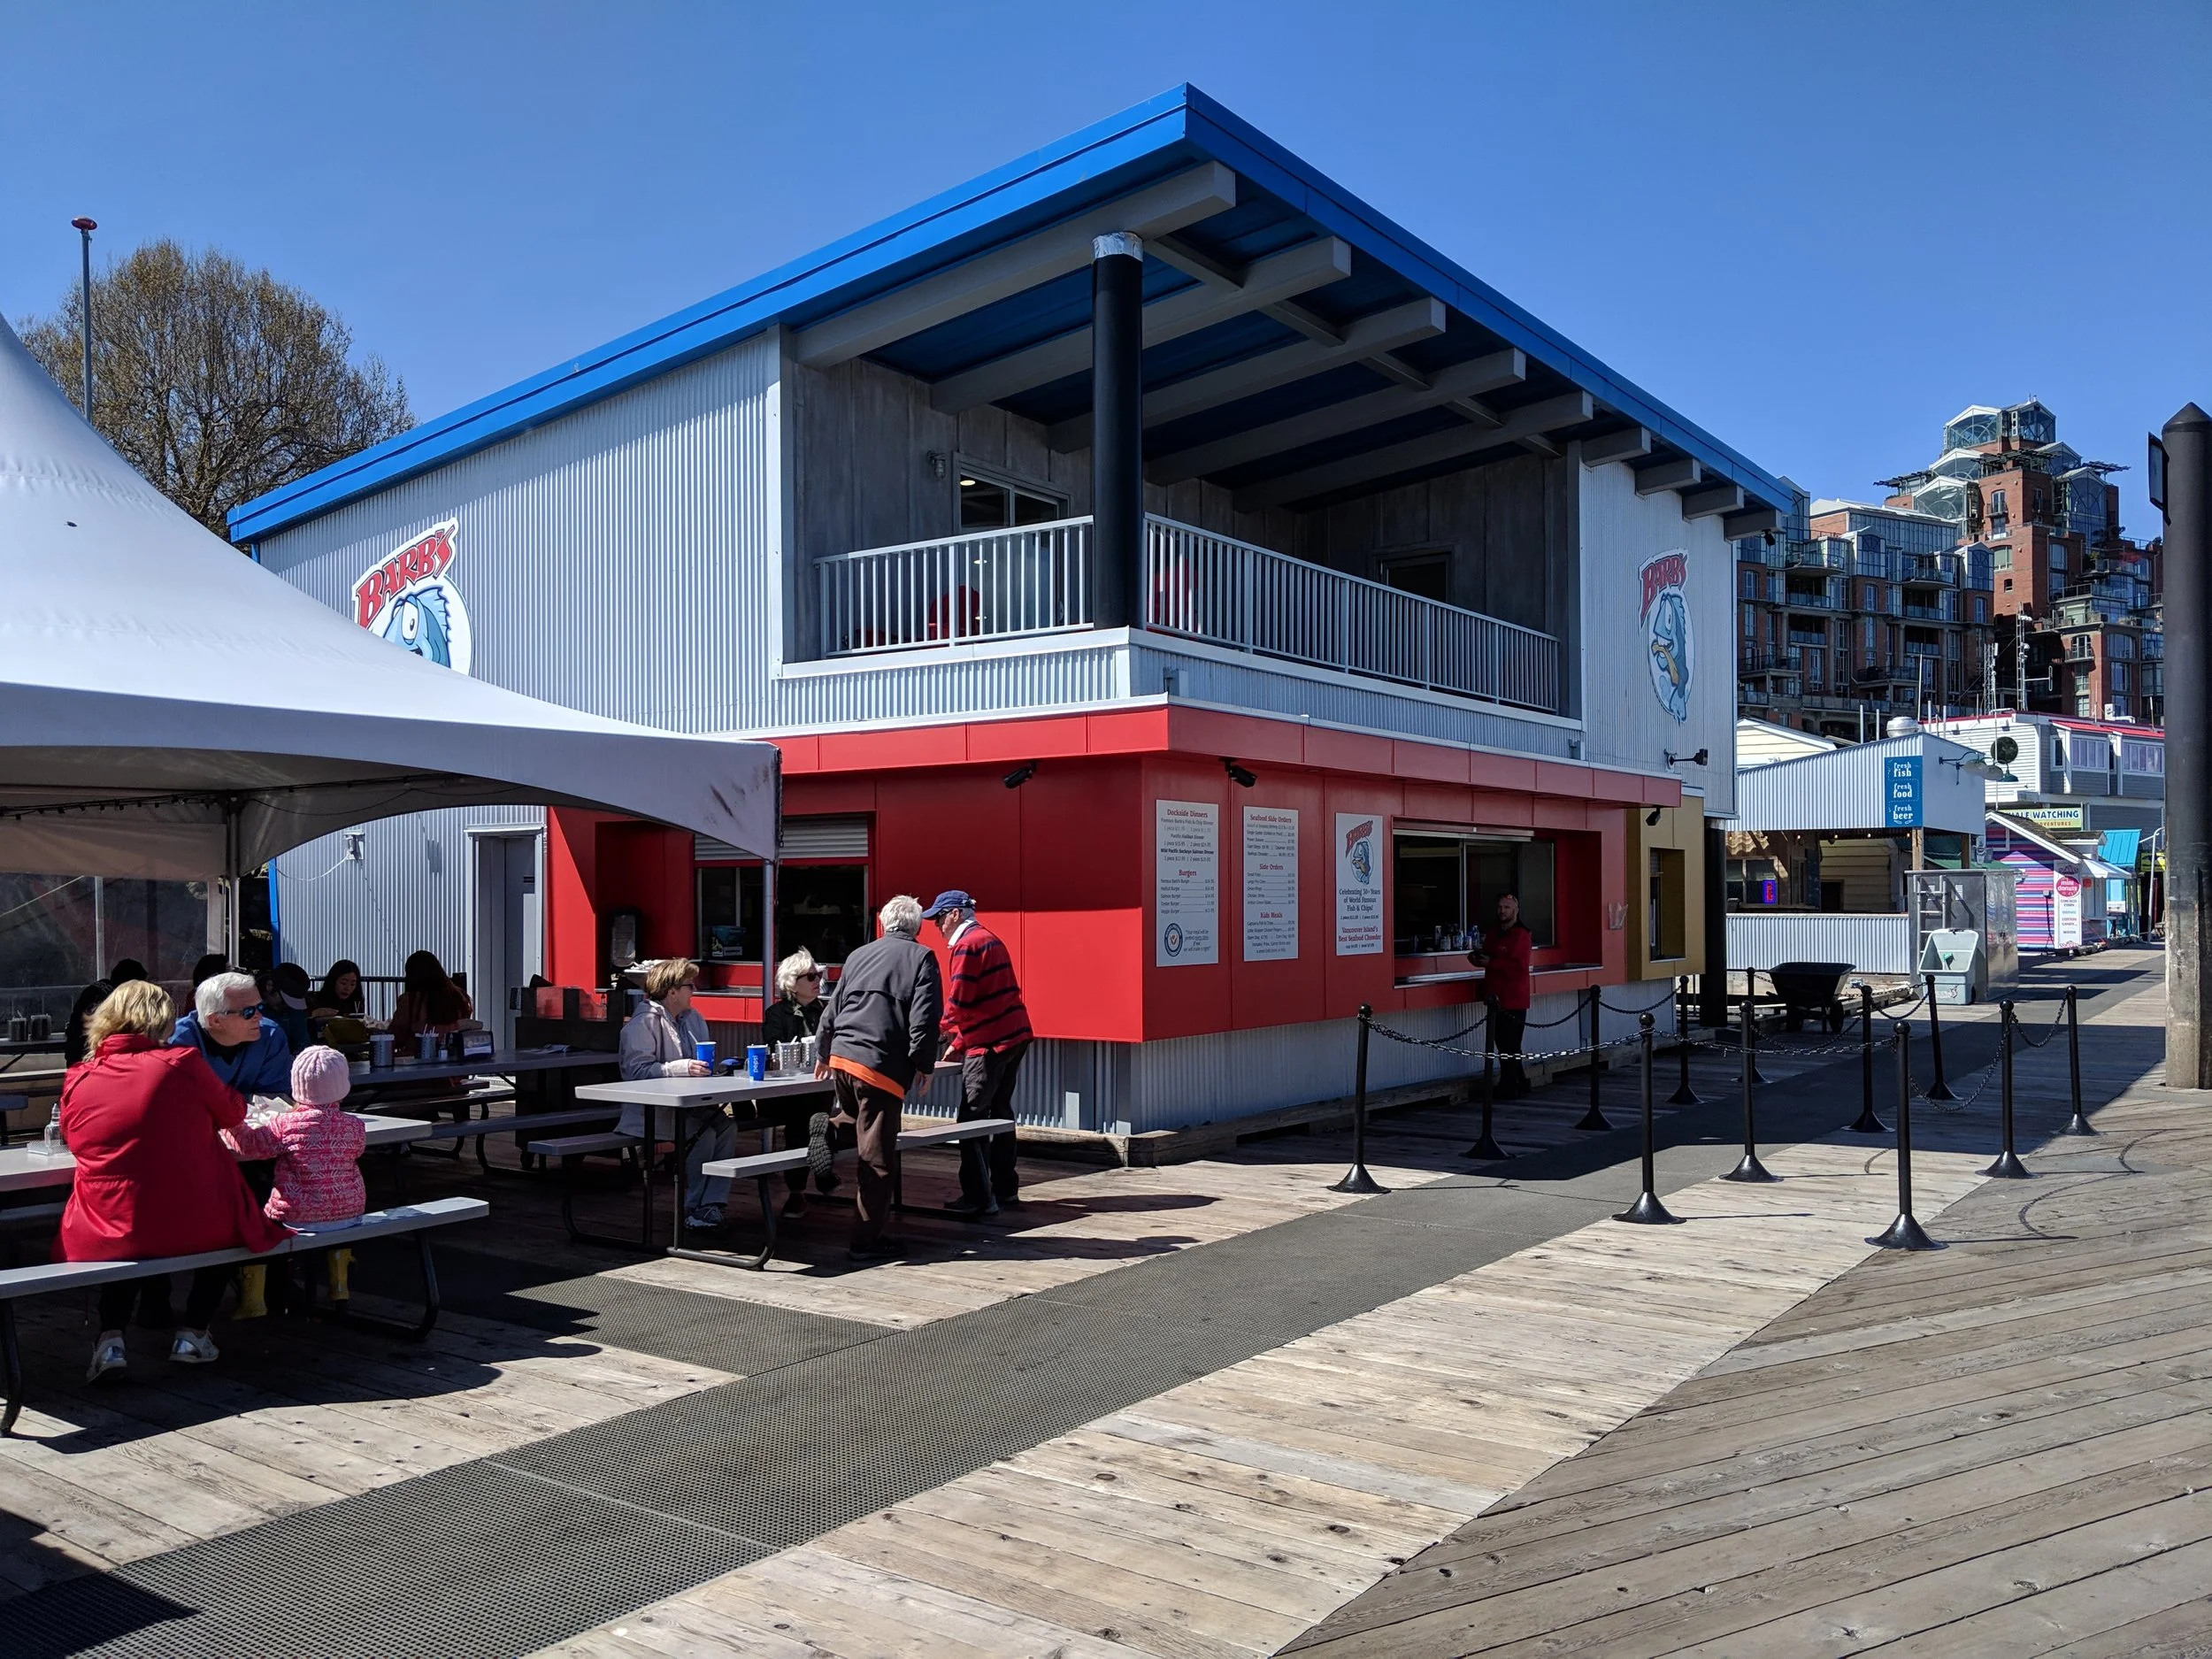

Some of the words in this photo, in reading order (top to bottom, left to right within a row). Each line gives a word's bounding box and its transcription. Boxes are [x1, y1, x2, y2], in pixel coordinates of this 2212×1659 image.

[356, 524, 456, 630] BARB'S
[1641, 553, 1687, 628] BARB'S
[1893, 768, 1911, 777] fish
[1893, 788, 1912, 798] food
[1893, 810, 1913, 820] beer
